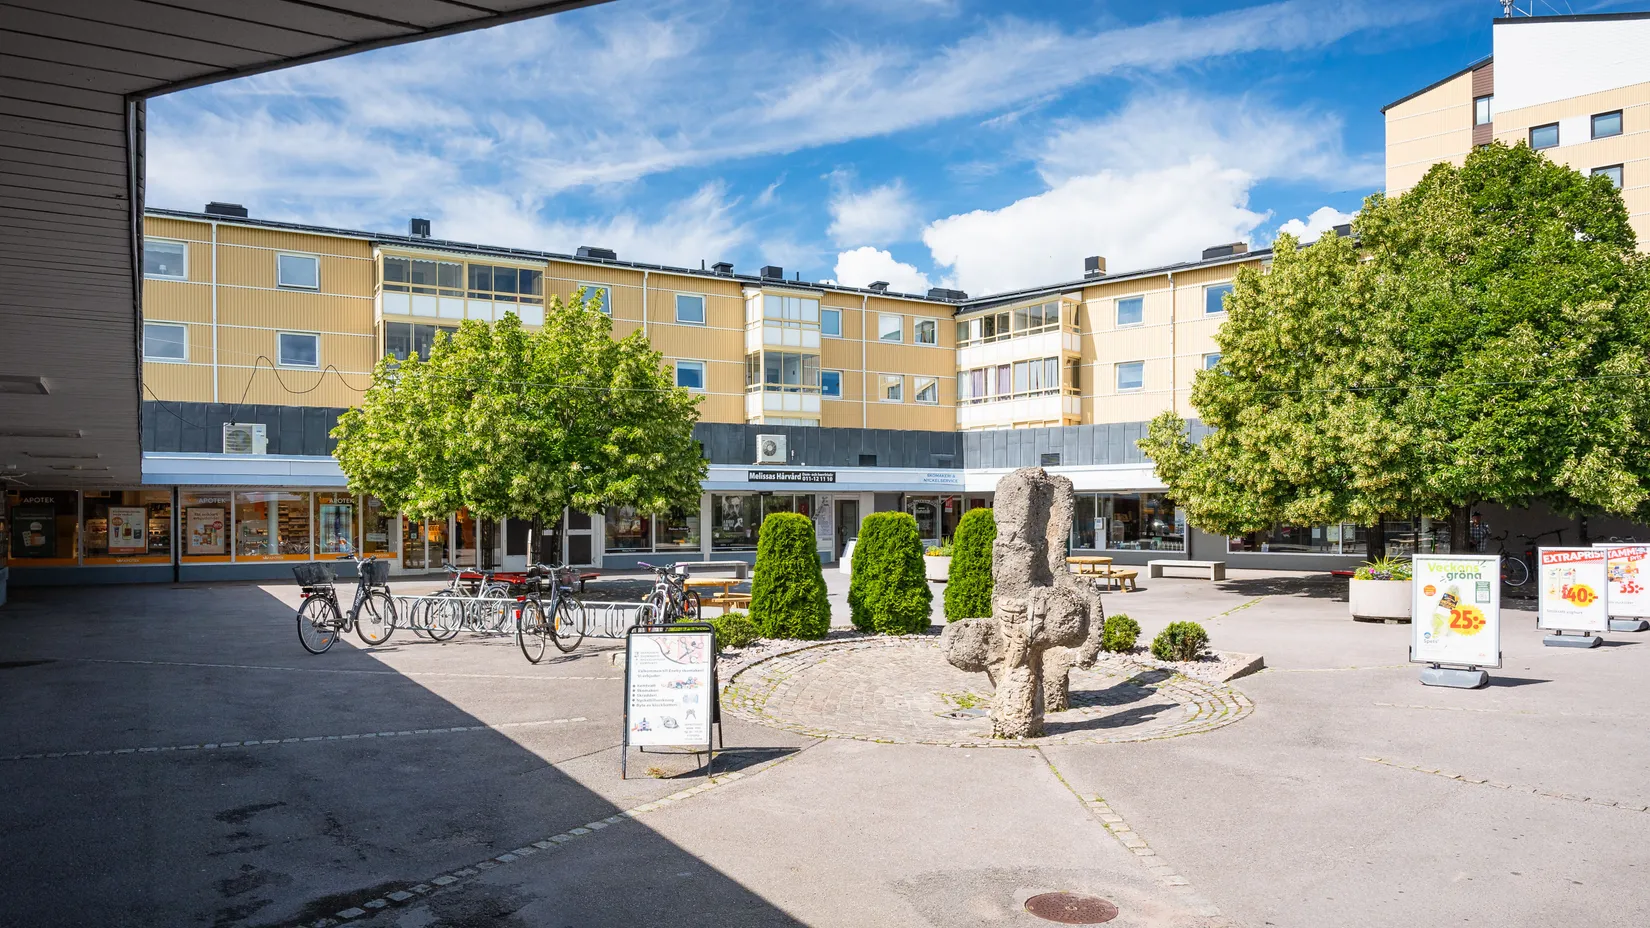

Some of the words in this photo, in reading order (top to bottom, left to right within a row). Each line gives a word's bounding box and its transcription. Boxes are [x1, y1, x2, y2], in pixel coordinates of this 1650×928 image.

[749, 472, 775, 480] Melissas
[776, 471, 801, 480] Hårvård
[1427, 562, 1480, 573] Veckans
[1446, 570, 1482, 581] gröna
[1567, 587, 1599, 603] 40:-
[1450, 609, 1487, 630] 25:-
